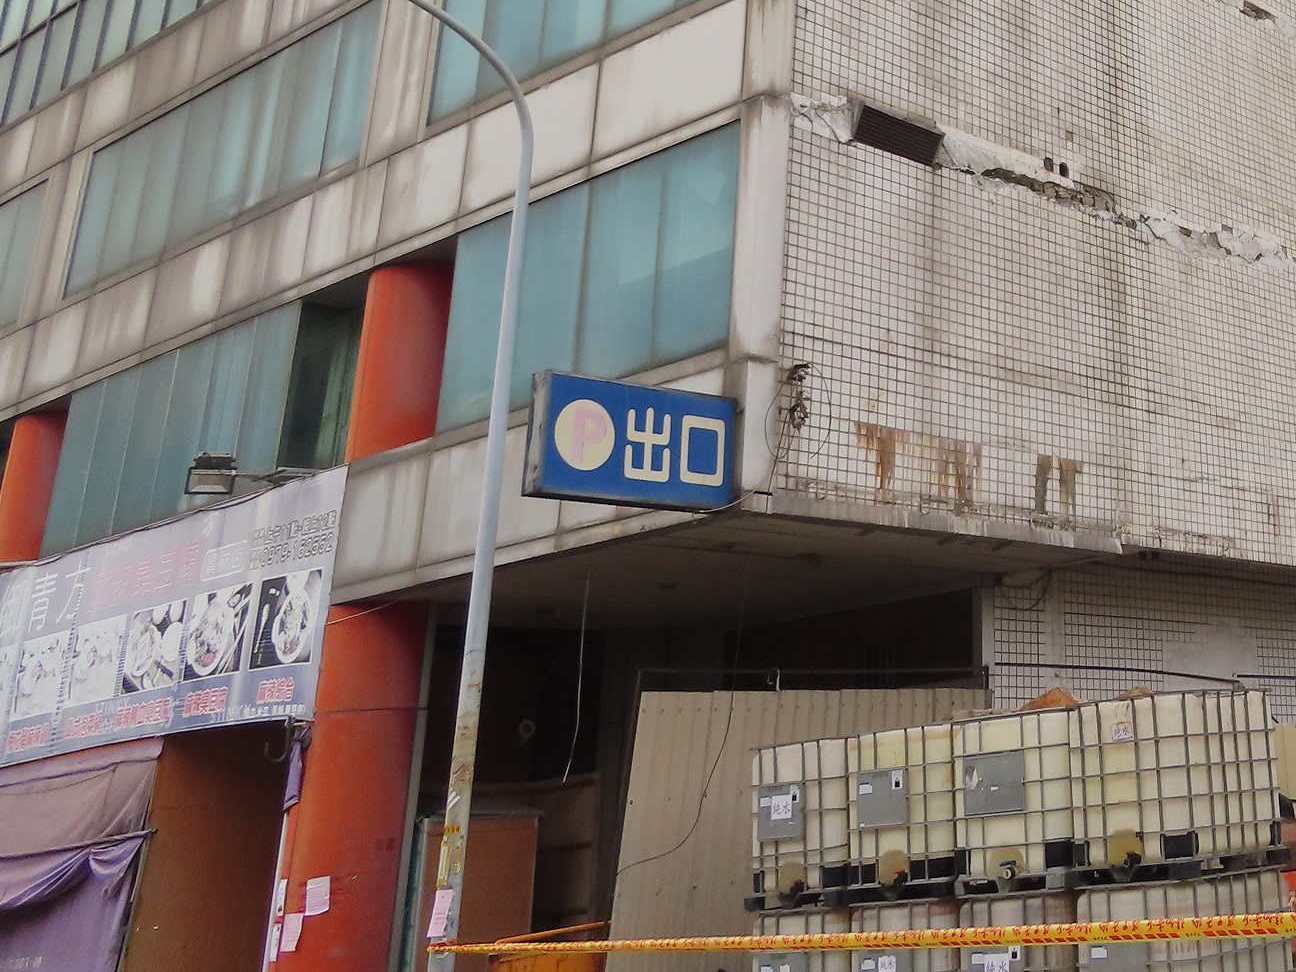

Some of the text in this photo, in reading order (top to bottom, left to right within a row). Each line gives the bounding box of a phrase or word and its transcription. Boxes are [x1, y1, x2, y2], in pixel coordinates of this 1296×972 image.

[572, 408, 608, 463] P
[624, 407, 726, 487] 出口
[773, 800, 790, 815] 純水
